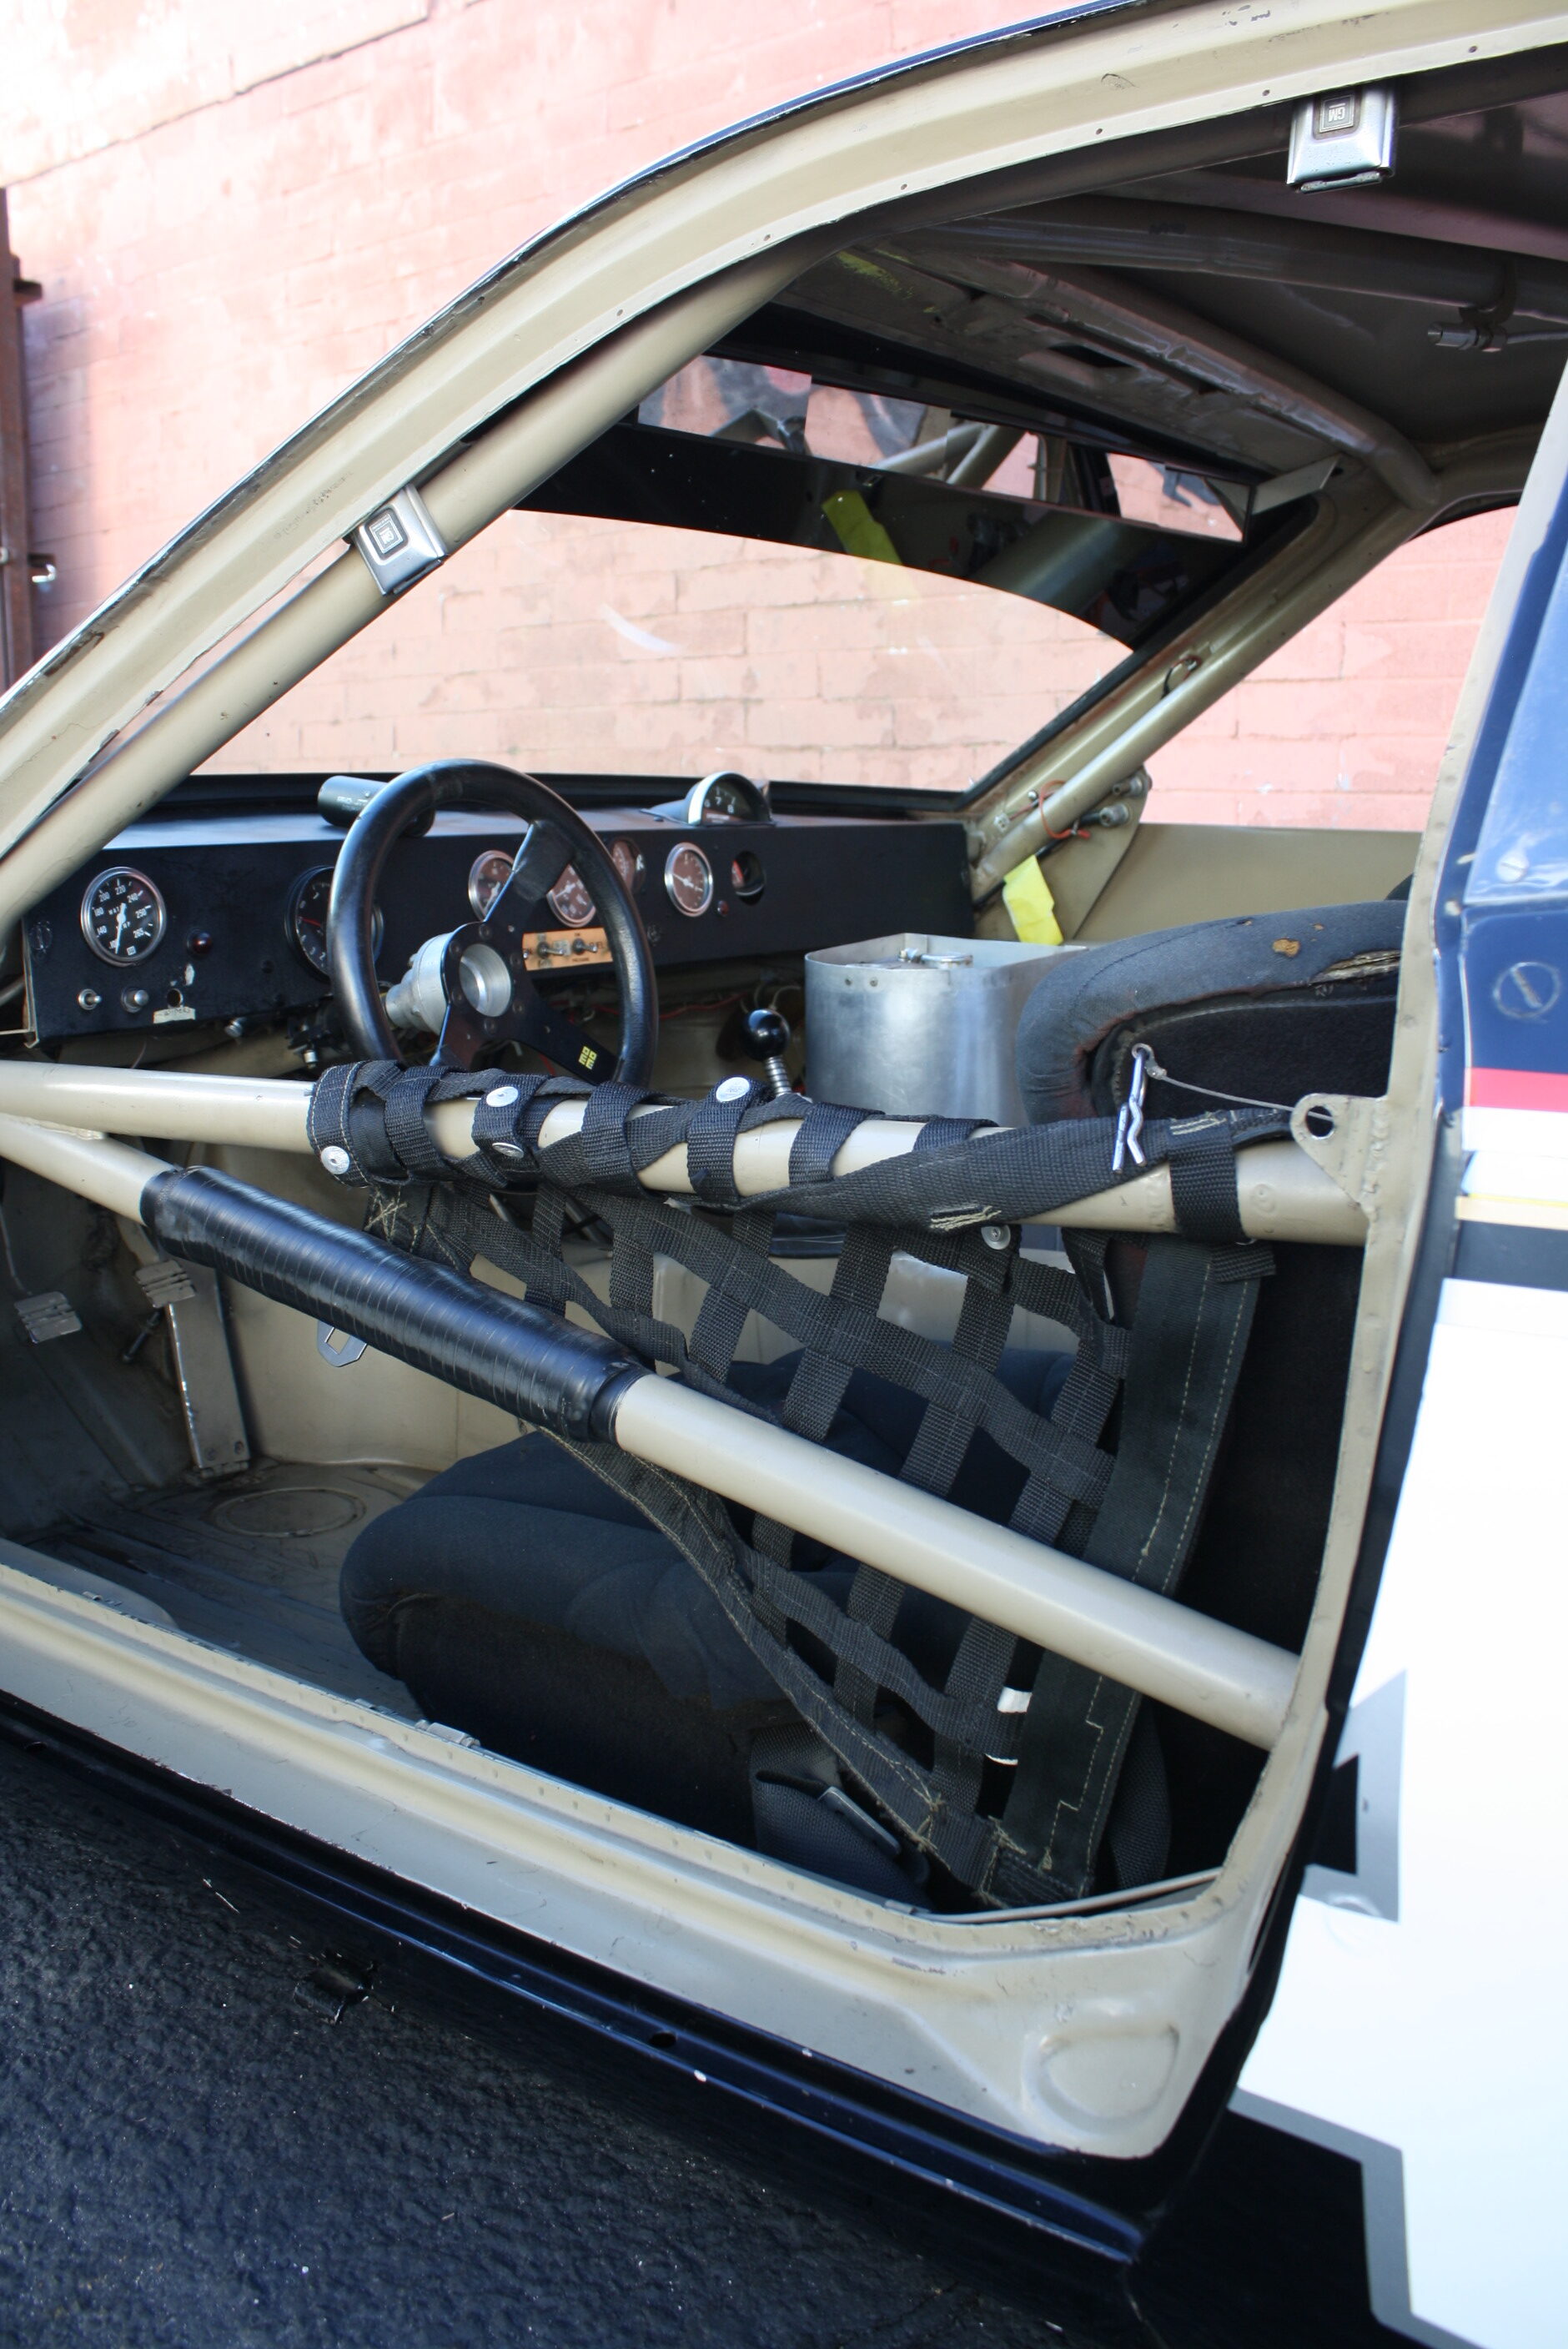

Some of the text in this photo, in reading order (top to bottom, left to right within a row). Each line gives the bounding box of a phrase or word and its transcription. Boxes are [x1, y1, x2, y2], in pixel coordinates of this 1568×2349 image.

[1328, 106, 1346, 123] GM
[115, 884, 127, 896] 220
[98, 891, 110, 903] 200
[127, 893, 138, 903] 240
[93, 907, 104, 918] 180
[135, 908, 147, 919] 250
[97, 925, 108, 935] 140
[133, 928, 145, 938] 265
